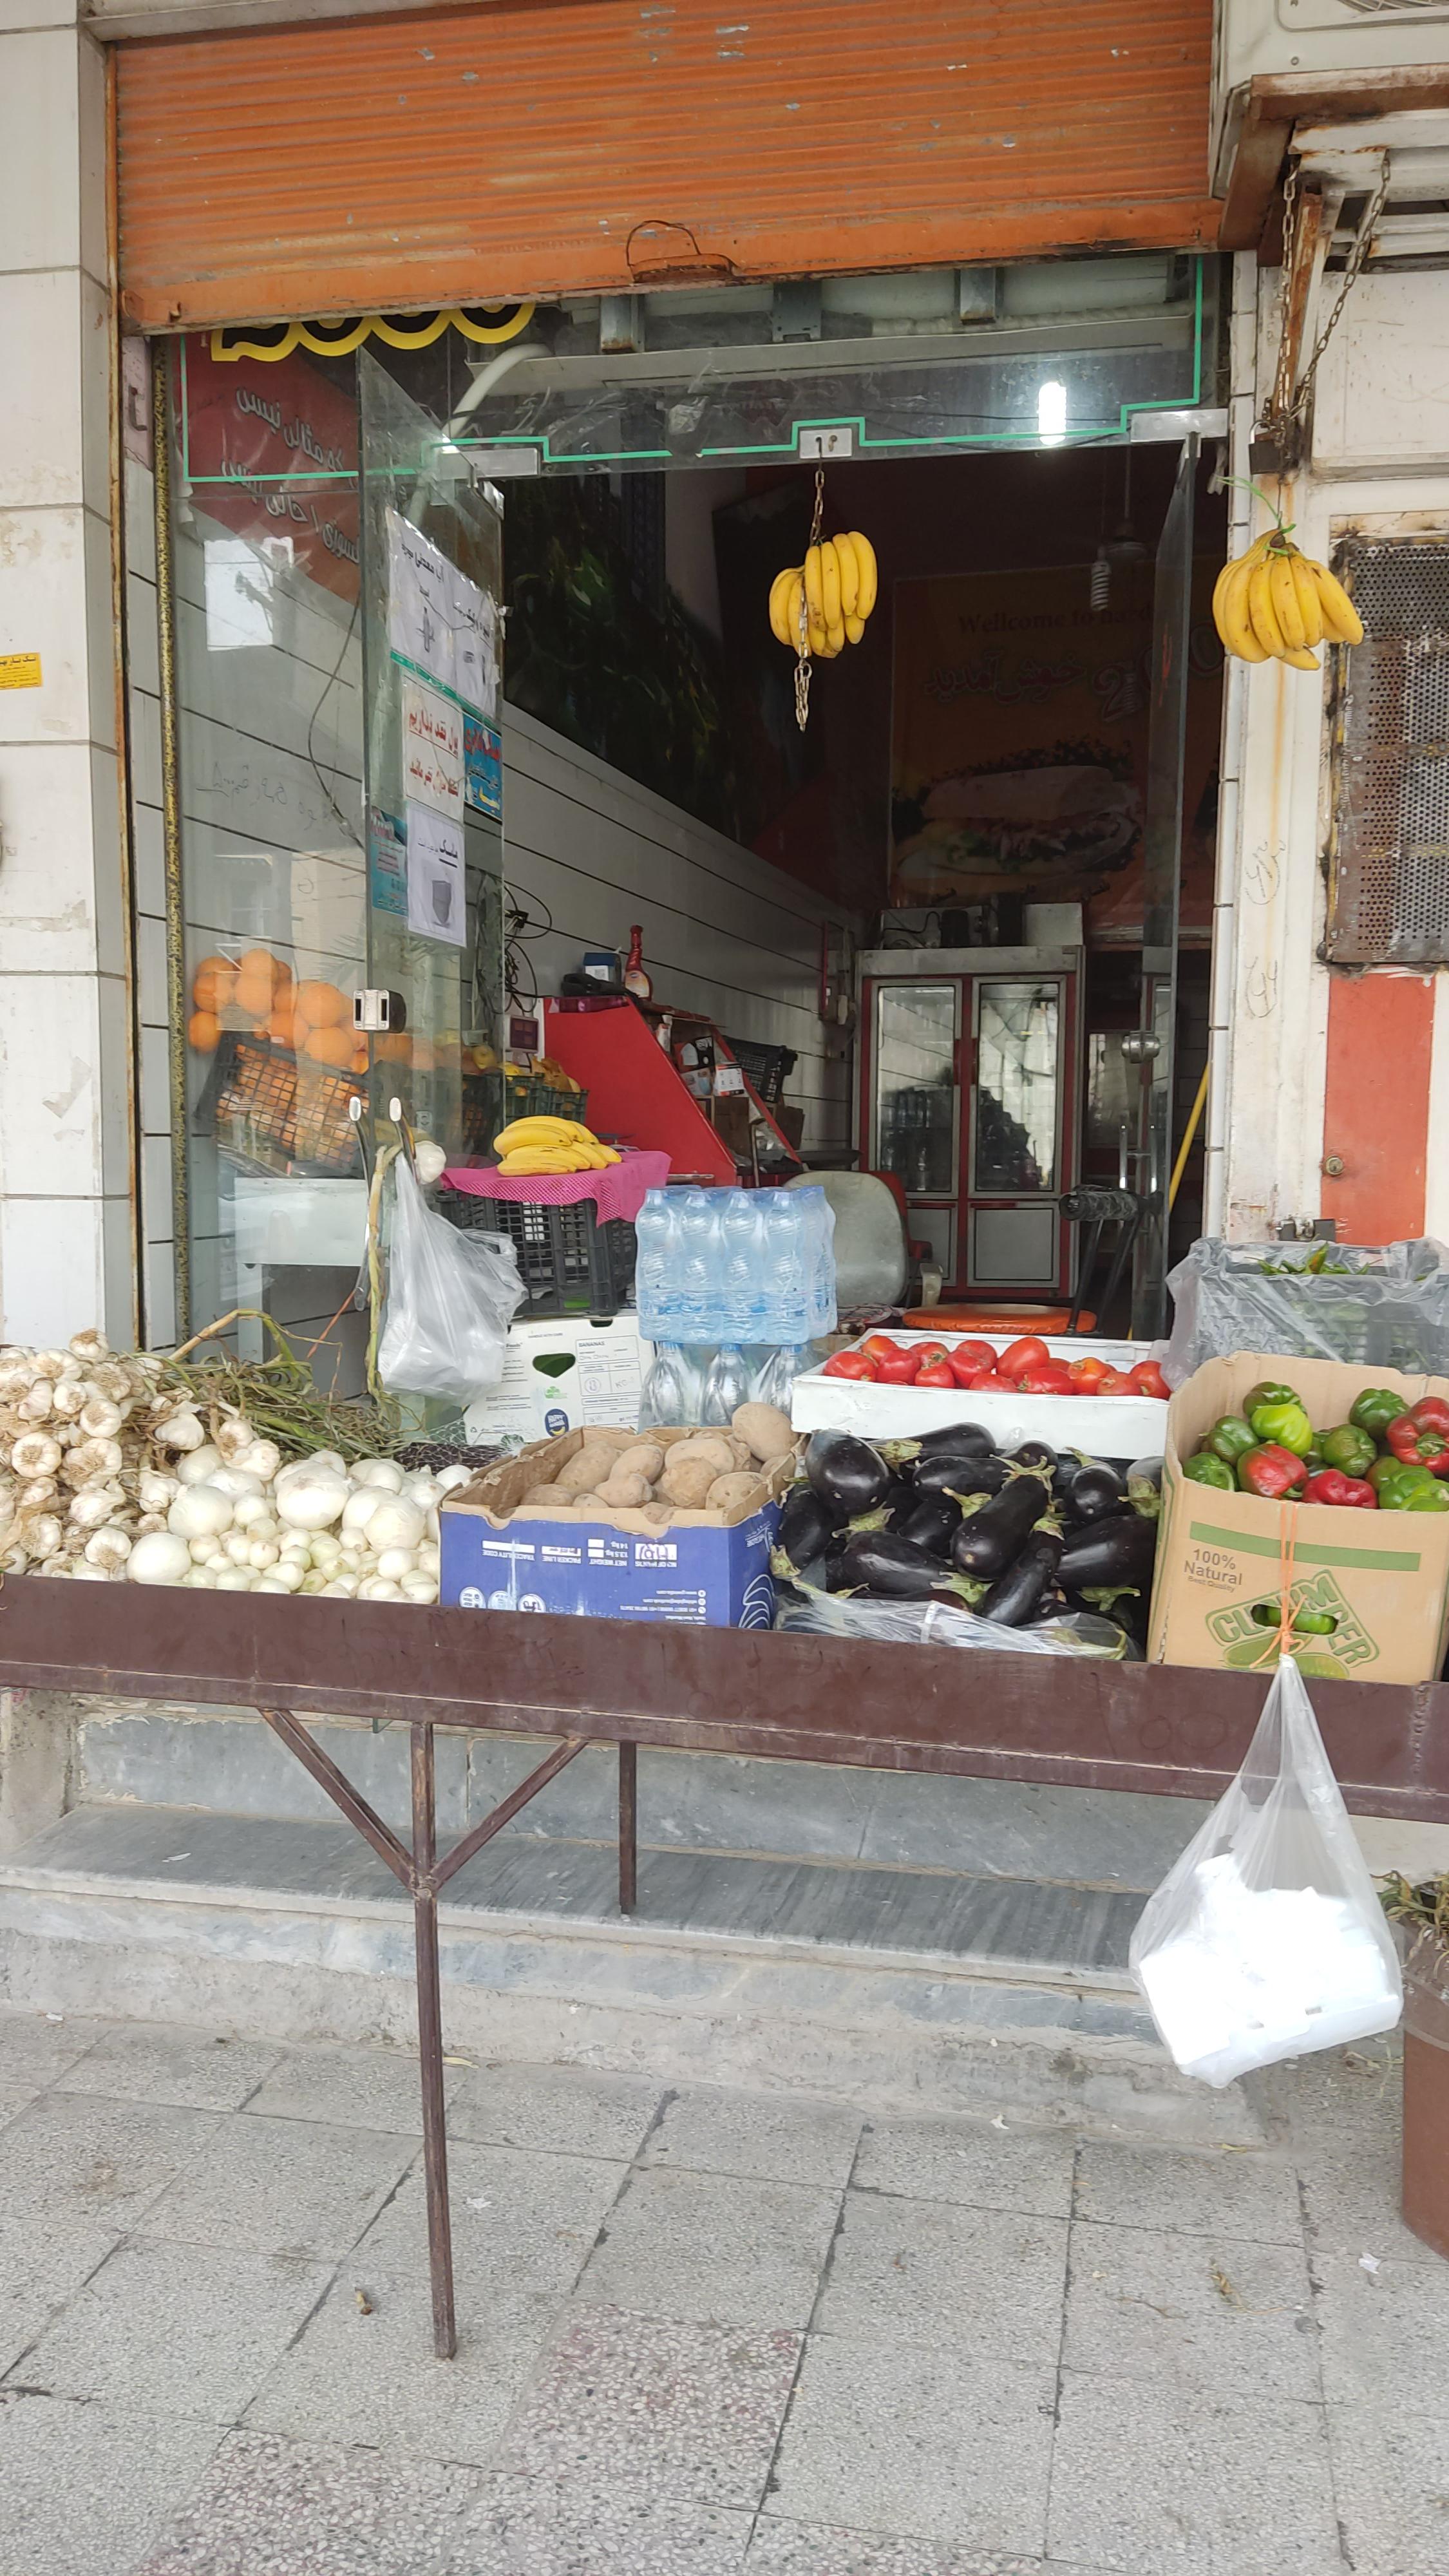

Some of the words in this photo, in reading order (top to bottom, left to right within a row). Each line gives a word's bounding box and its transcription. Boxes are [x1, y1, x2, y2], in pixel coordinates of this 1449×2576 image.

[925, 650, 1001, 701] آمدید
[1193, 1548, 1236, 1570] 100%
[1184, 1560, 1242, 1586] Natural
[1207, 1580, 1235, 1594] Quality
